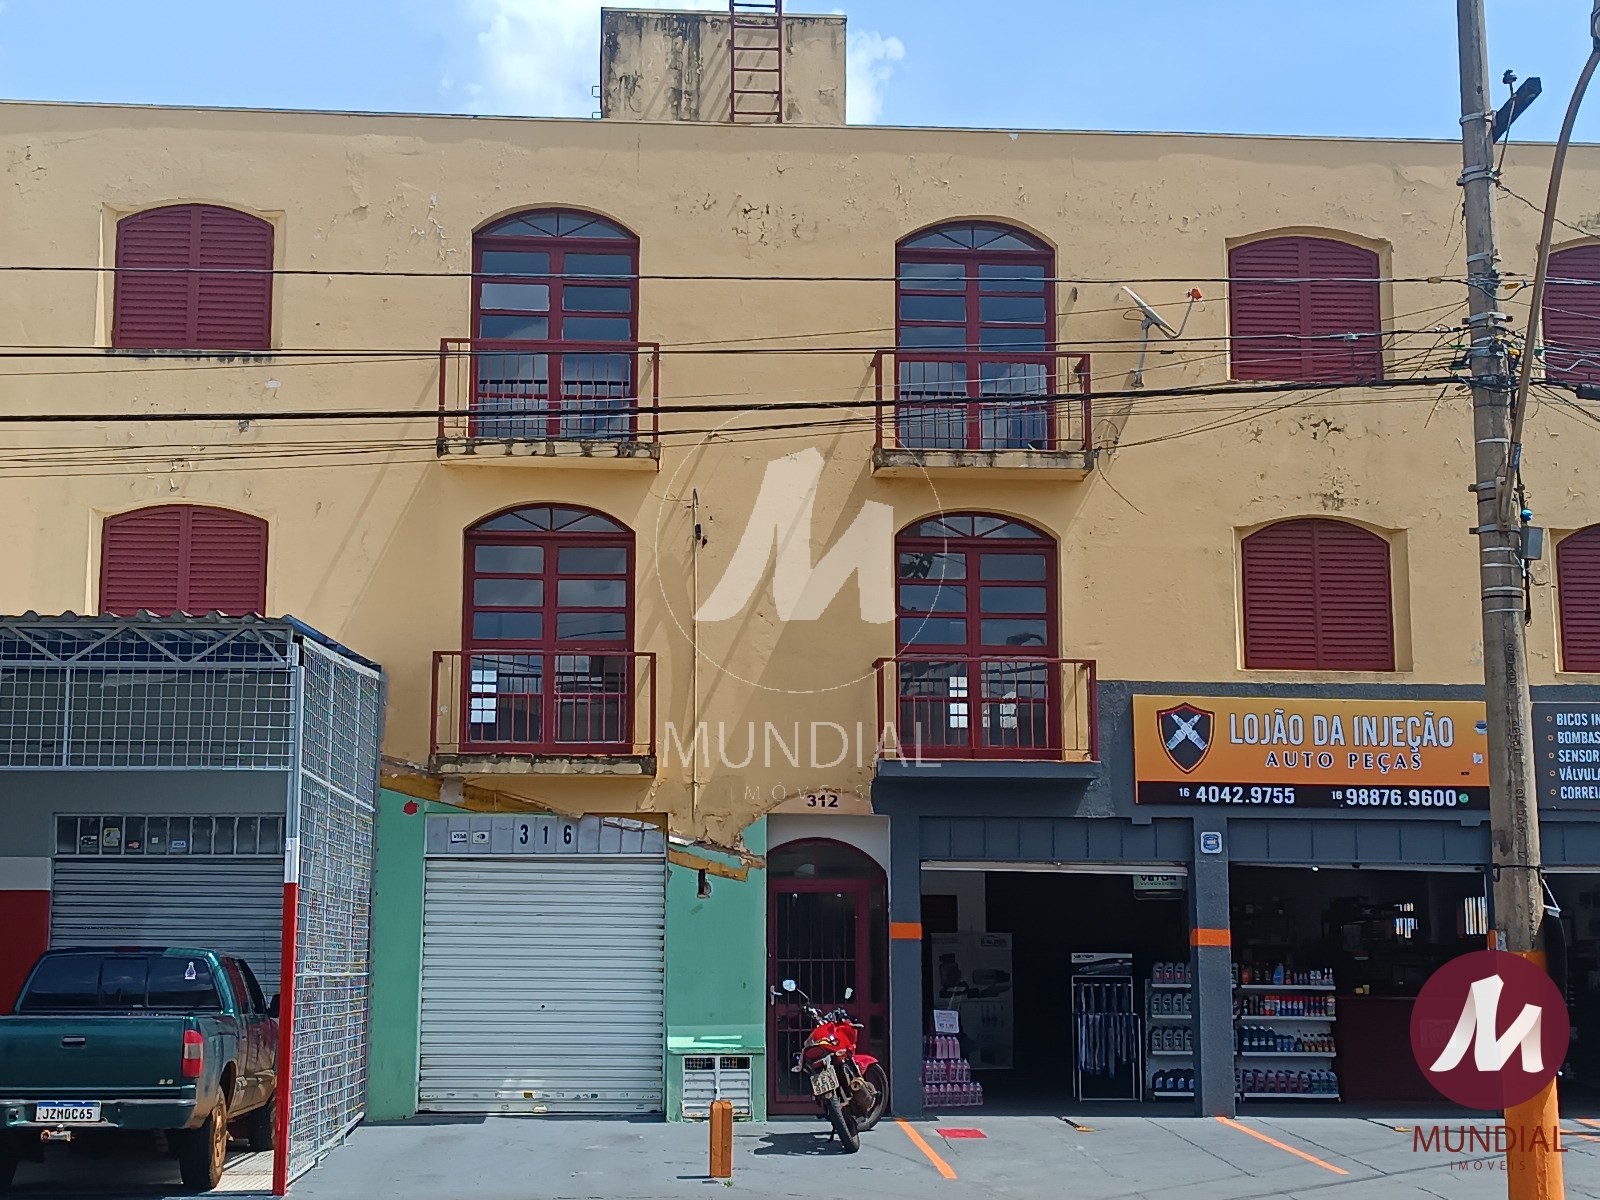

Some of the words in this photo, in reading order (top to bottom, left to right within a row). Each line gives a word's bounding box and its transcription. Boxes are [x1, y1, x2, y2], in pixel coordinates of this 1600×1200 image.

[1556, 713, 1588, 726] BICOS
[1229, 708, 1305, 746] LOJÃO
[1312, 715, 1346, 747] DA
[1353, 711, 1454, 752] INJEÇÃO
[1557, 731, 1600, 744] BOMBAS
[1265, 751, 1334, 769] AUTO
[1347, 752, 1422, 774] PEÇAS
[806, 794, 839, 808] 312
[1178, 787, 1190, 797] 16
[1195, 785, 1295, 804] 4042.9755
[1345, 788, 1457, 806] 98876.9600
[1560, 785, 1600, 800] CORREI
[519, 824, 572, 845] 316
